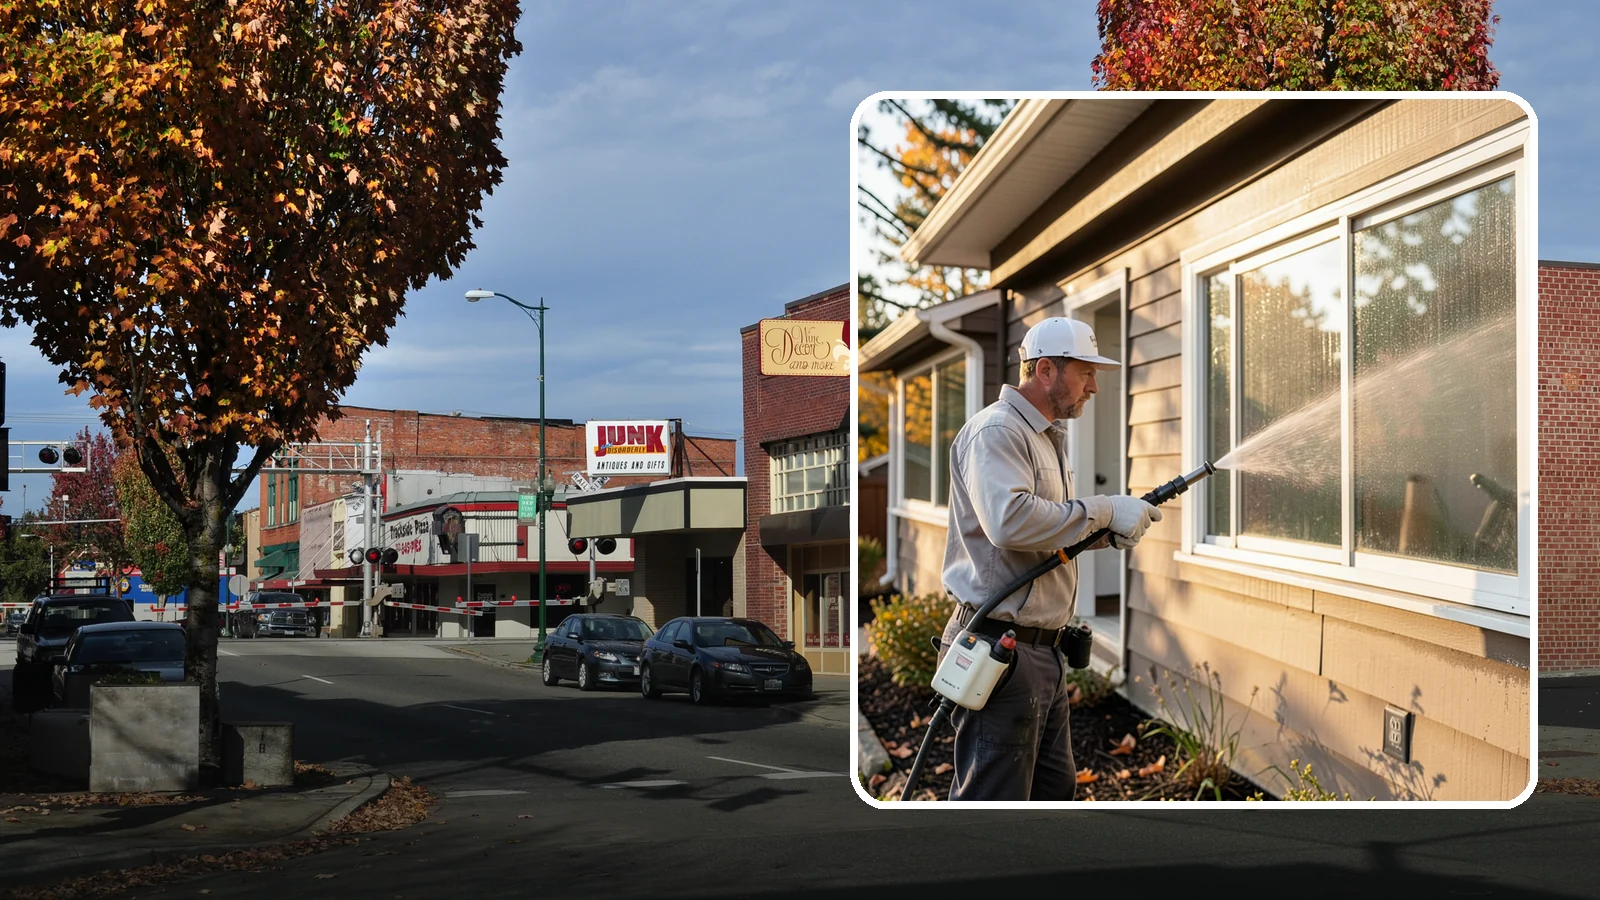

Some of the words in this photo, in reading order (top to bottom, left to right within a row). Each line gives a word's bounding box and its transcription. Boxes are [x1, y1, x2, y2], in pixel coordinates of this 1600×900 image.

[595, 425, 664, 457] JUNK
[607, 446, 645, 454] DISORDERLY
[597, 461, 628, 470] ANTIQUES
[631, 461, 644, 470] AND
[647, 460, 665, 470] GIFTS
[390, 521, 413, 540] Trackside
[414, 519, 429, 535] Pizza
